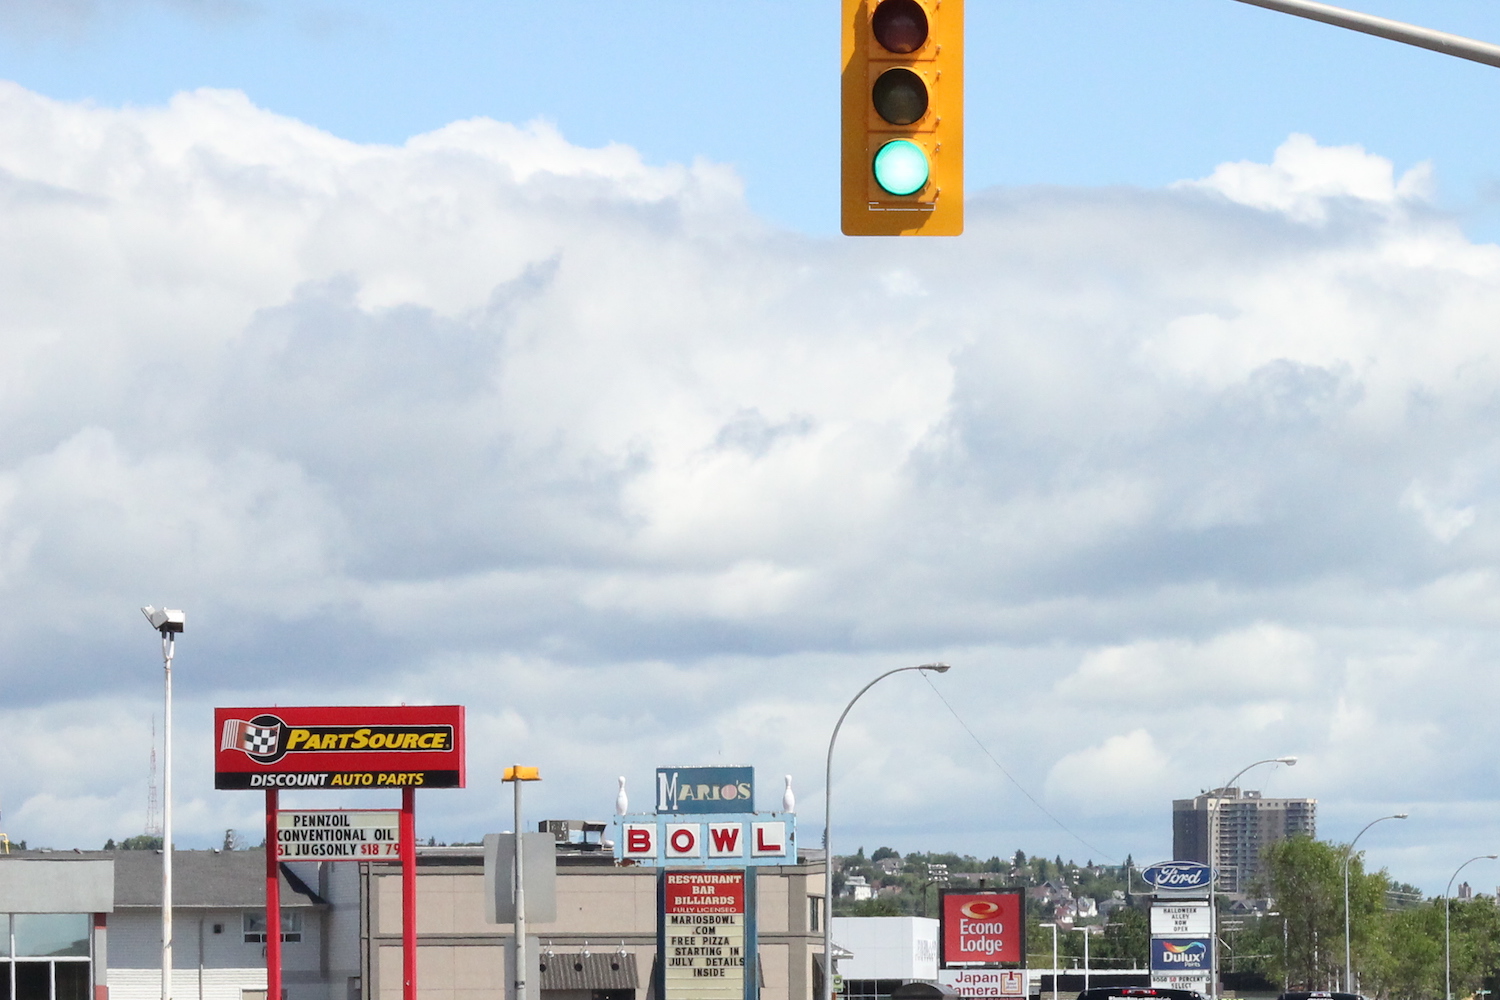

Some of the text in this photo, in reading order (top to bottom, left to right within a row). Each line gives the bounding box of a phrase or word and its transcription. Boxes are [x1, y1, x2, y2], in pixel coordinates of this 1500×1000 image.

[286, 728, 447, 750] PARTSOURCE
[250, 773, 424, 787] DISCOUNT AUTO PARTS
[658, 772, 751, 811] MARIO'S
[293, 815, 350, 827] PENNZOIL
[277, 829, 395, 841] CONVENTIONAL OIL
[628, 828, 781, 853] BOWL
[277, 844, 292, 856] 5L
[360, 844, 380, 855] $18
[668, 875, 742, 884] RESTAURANT
[1157, 866, 1202, 885] Ford
[692, 886, 715, 895] BAR
[674, 896, 735, 905] BILLIARDS
[671, 915, 735, 924] MARIOSBOWL
[692, 926, 716, 935] .COM
[960, 918, 1003, 935] Econo
[671, 937, 730, 945] FREE PIZZA
[960, 935, 1003, 955] Lodge
[675, 947, 740, 956] STARTING IN
[1163, 951, 1201, 963] Dulux
[669, 958, 745, 966] JULY DETAILS
[693, 968, 725, 977] INSIDE
[955, 971, 999, 985] Japan
[947, 984, 999, 996] amera
